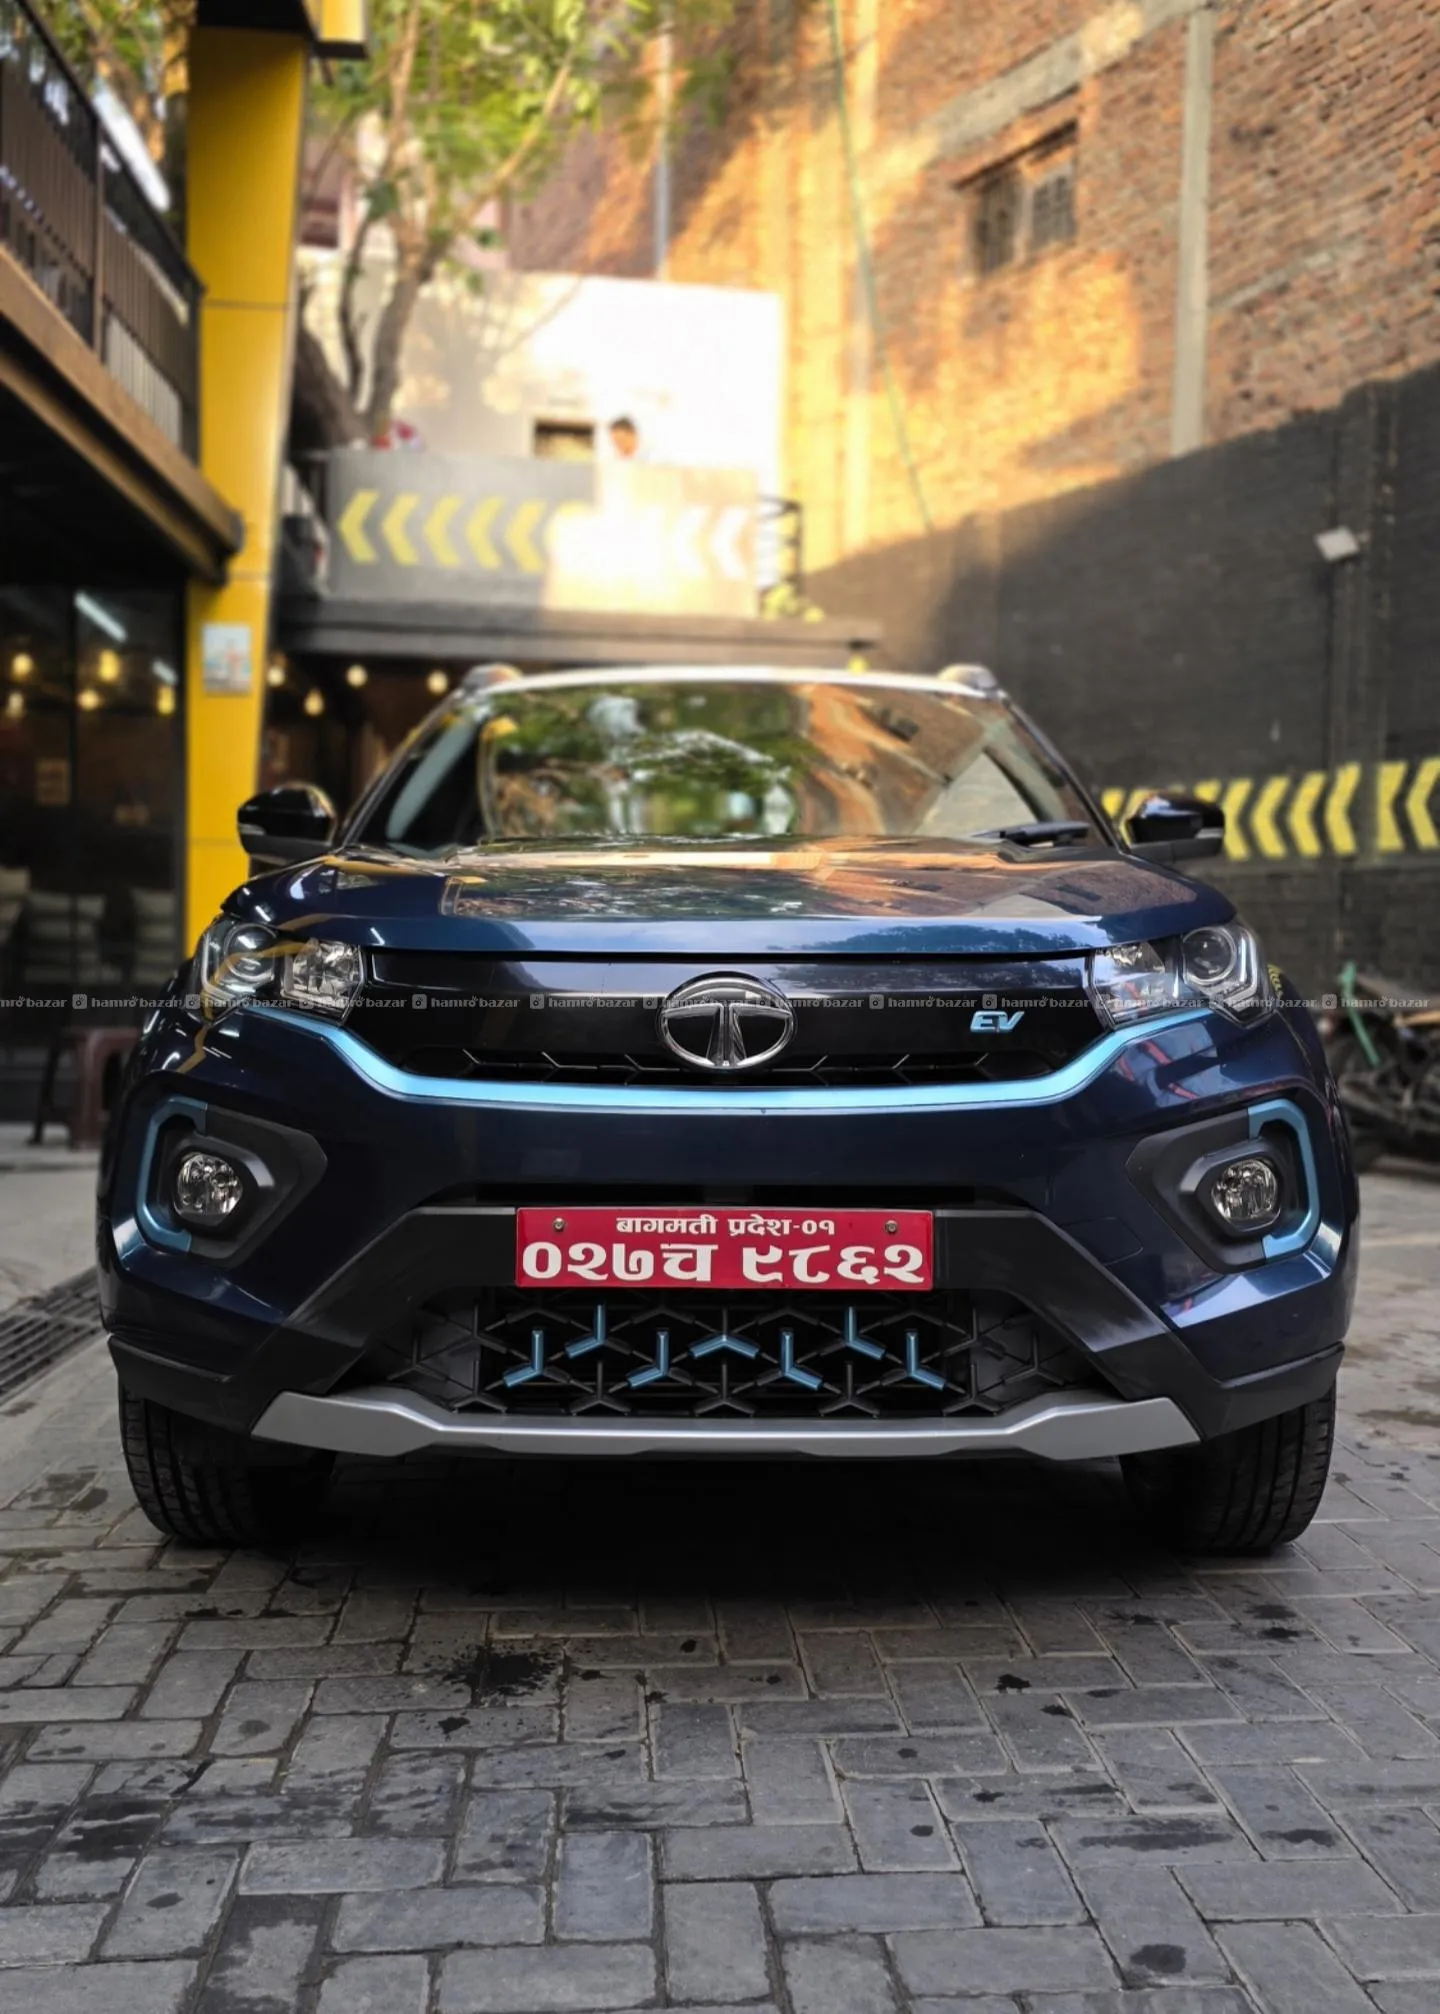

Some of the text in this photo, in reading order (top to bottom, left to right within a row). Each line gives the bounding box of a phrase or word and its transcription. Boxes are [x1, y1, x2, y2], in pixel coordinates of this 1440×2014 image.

[970, 1010, 1025, 1032] EV
[616, 1214, 834, 1237] बागमती प्रदेश-०१
[522, 1241, 924, 1285] ०२७च ९८६२
